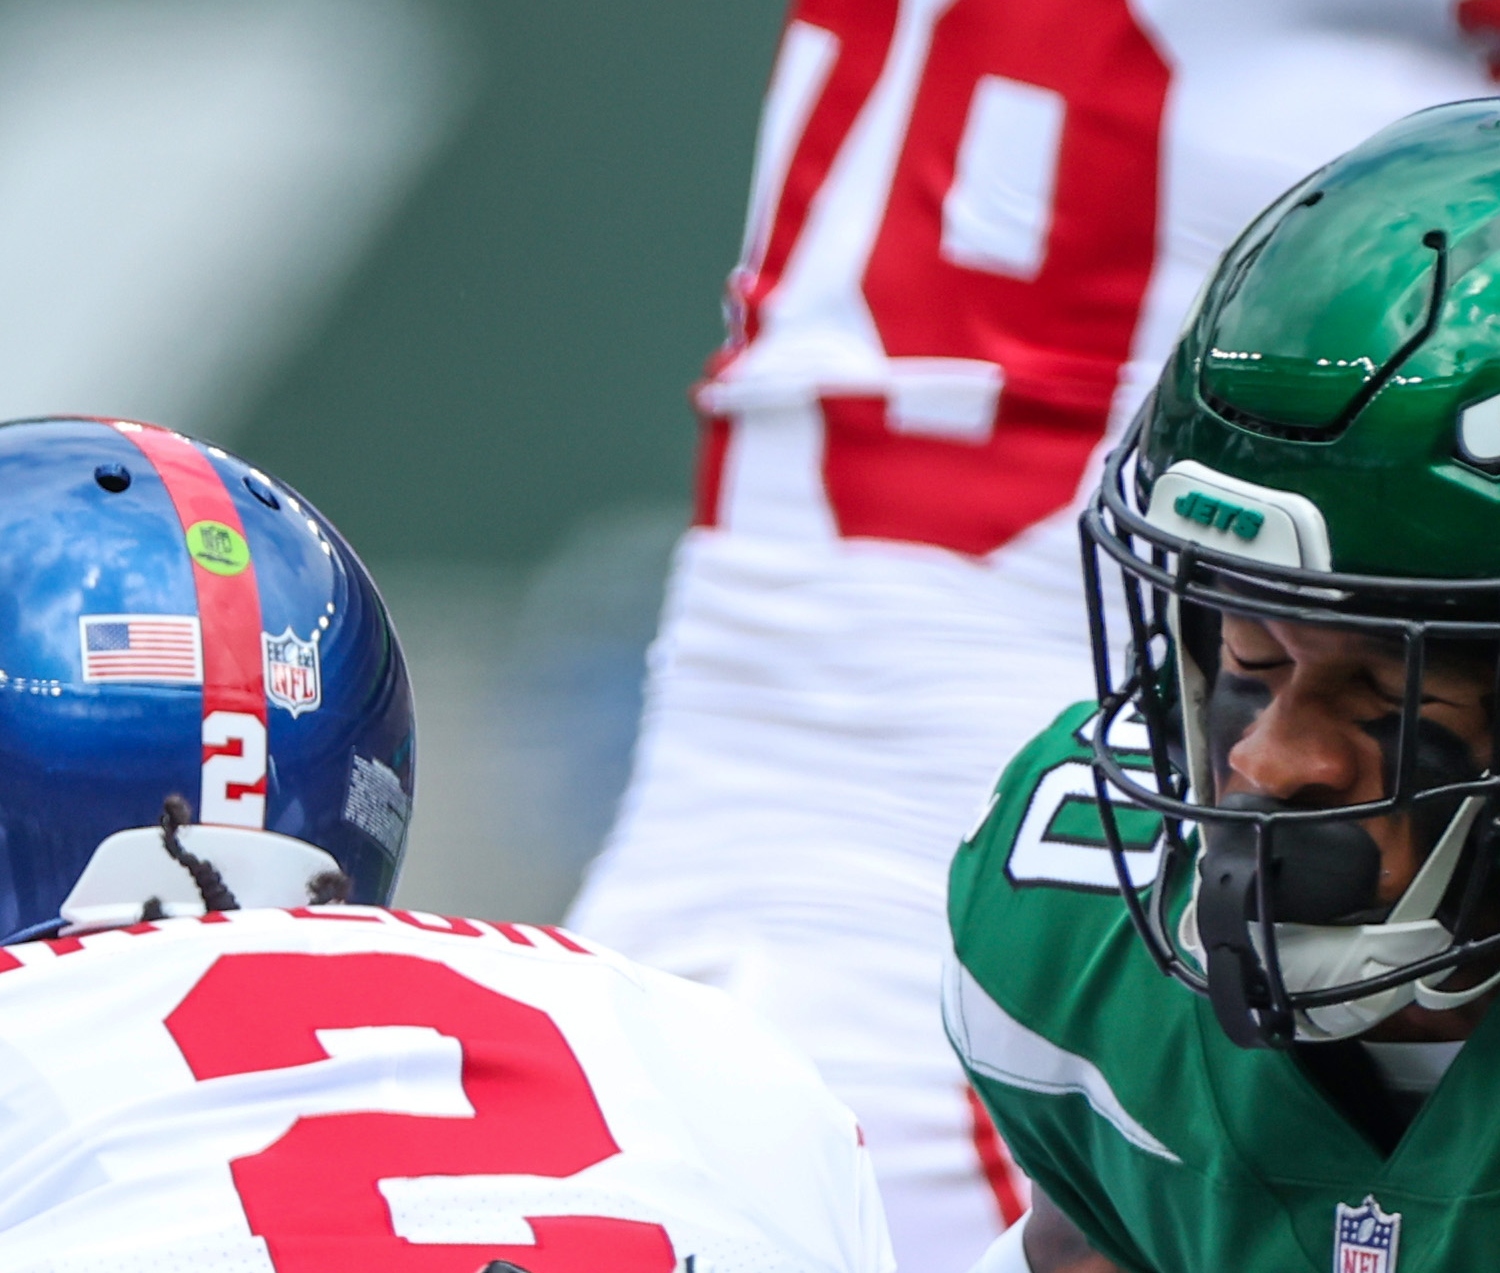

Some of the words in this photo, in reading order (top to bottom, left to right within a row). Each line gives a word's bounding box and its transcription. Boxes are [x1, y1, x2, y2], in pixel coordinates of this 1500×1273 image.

[1174, 490, 1265, 540] JETS
[272, 662, 315, 702] NFL
[200, 710, 267, 831] 2
